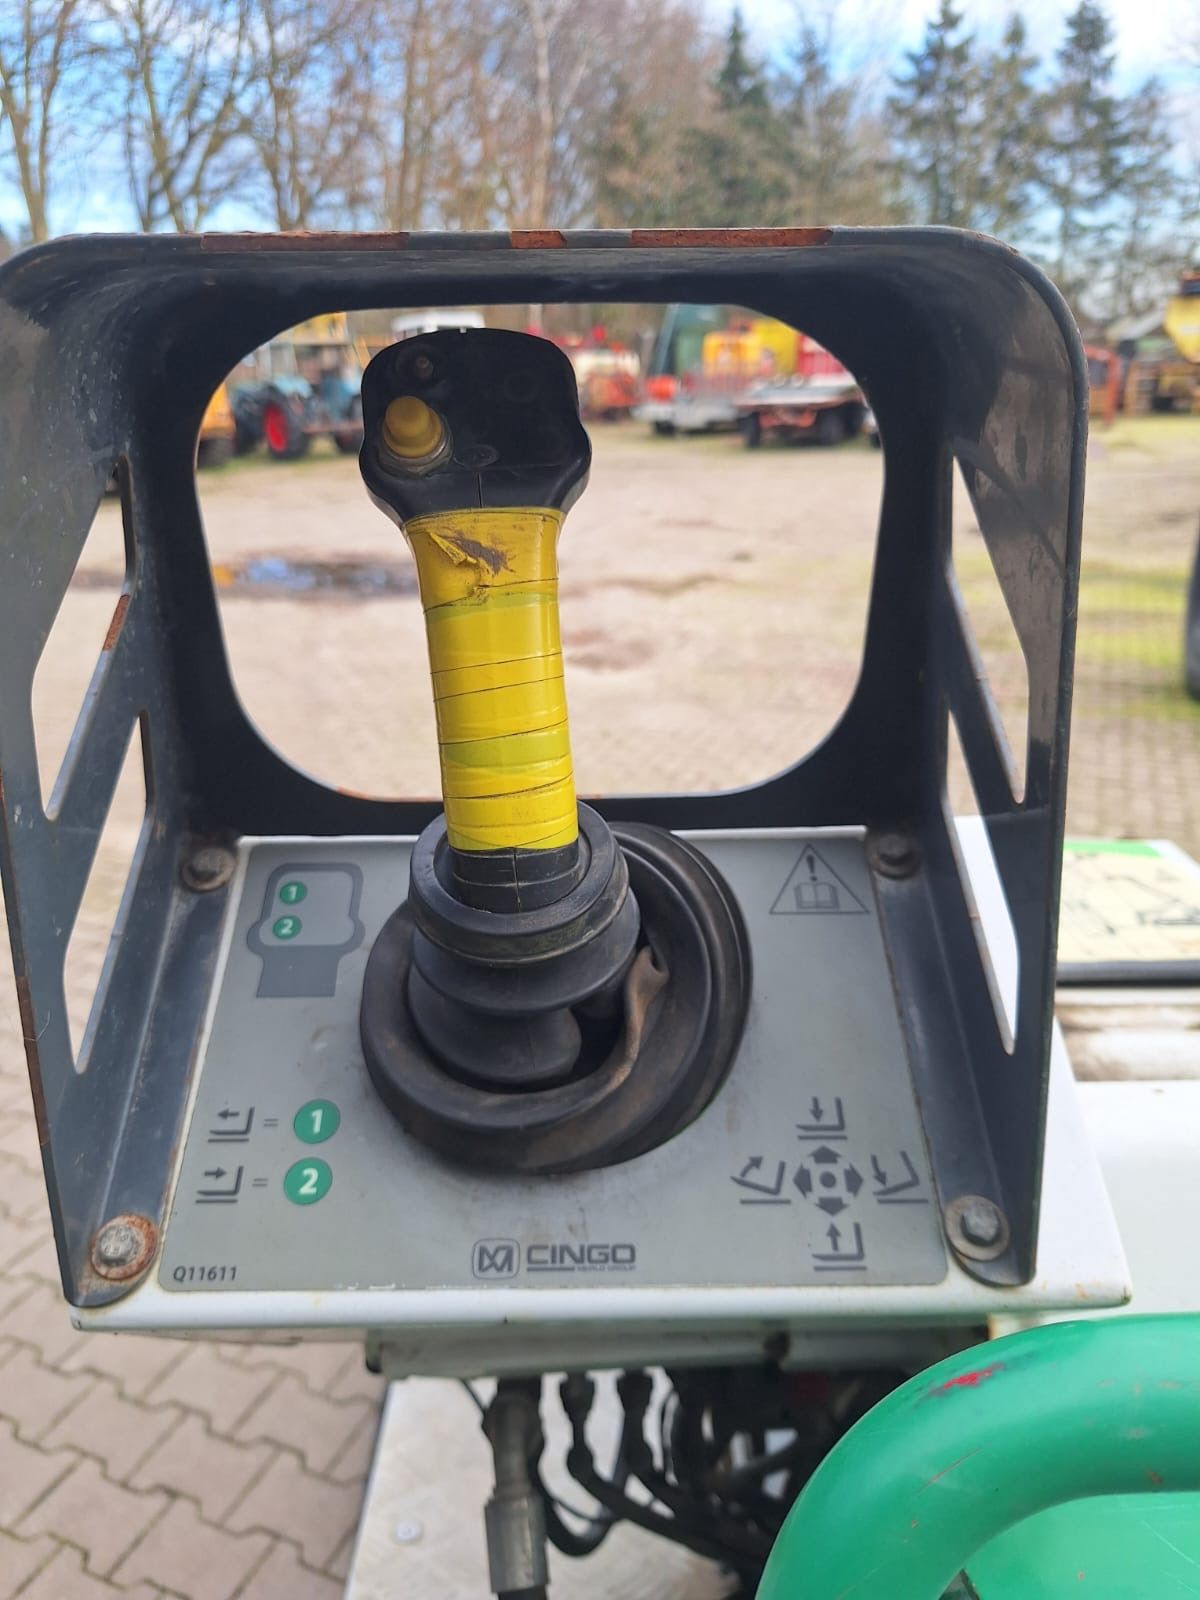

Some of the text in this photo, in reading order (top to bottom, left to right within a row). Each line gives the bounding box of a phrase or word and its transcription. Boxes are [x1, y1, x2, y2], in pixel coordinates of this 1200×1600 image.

[288, 885, 298, 901] 1
[281, 919, 293, 935] 2
[311, 1108, 323, 1134] 1
[299, 1167, 319, 1195] 2
[526, 1243, 636, 1265] CINGO
[173, 1265, 238, 1283] Q11611
